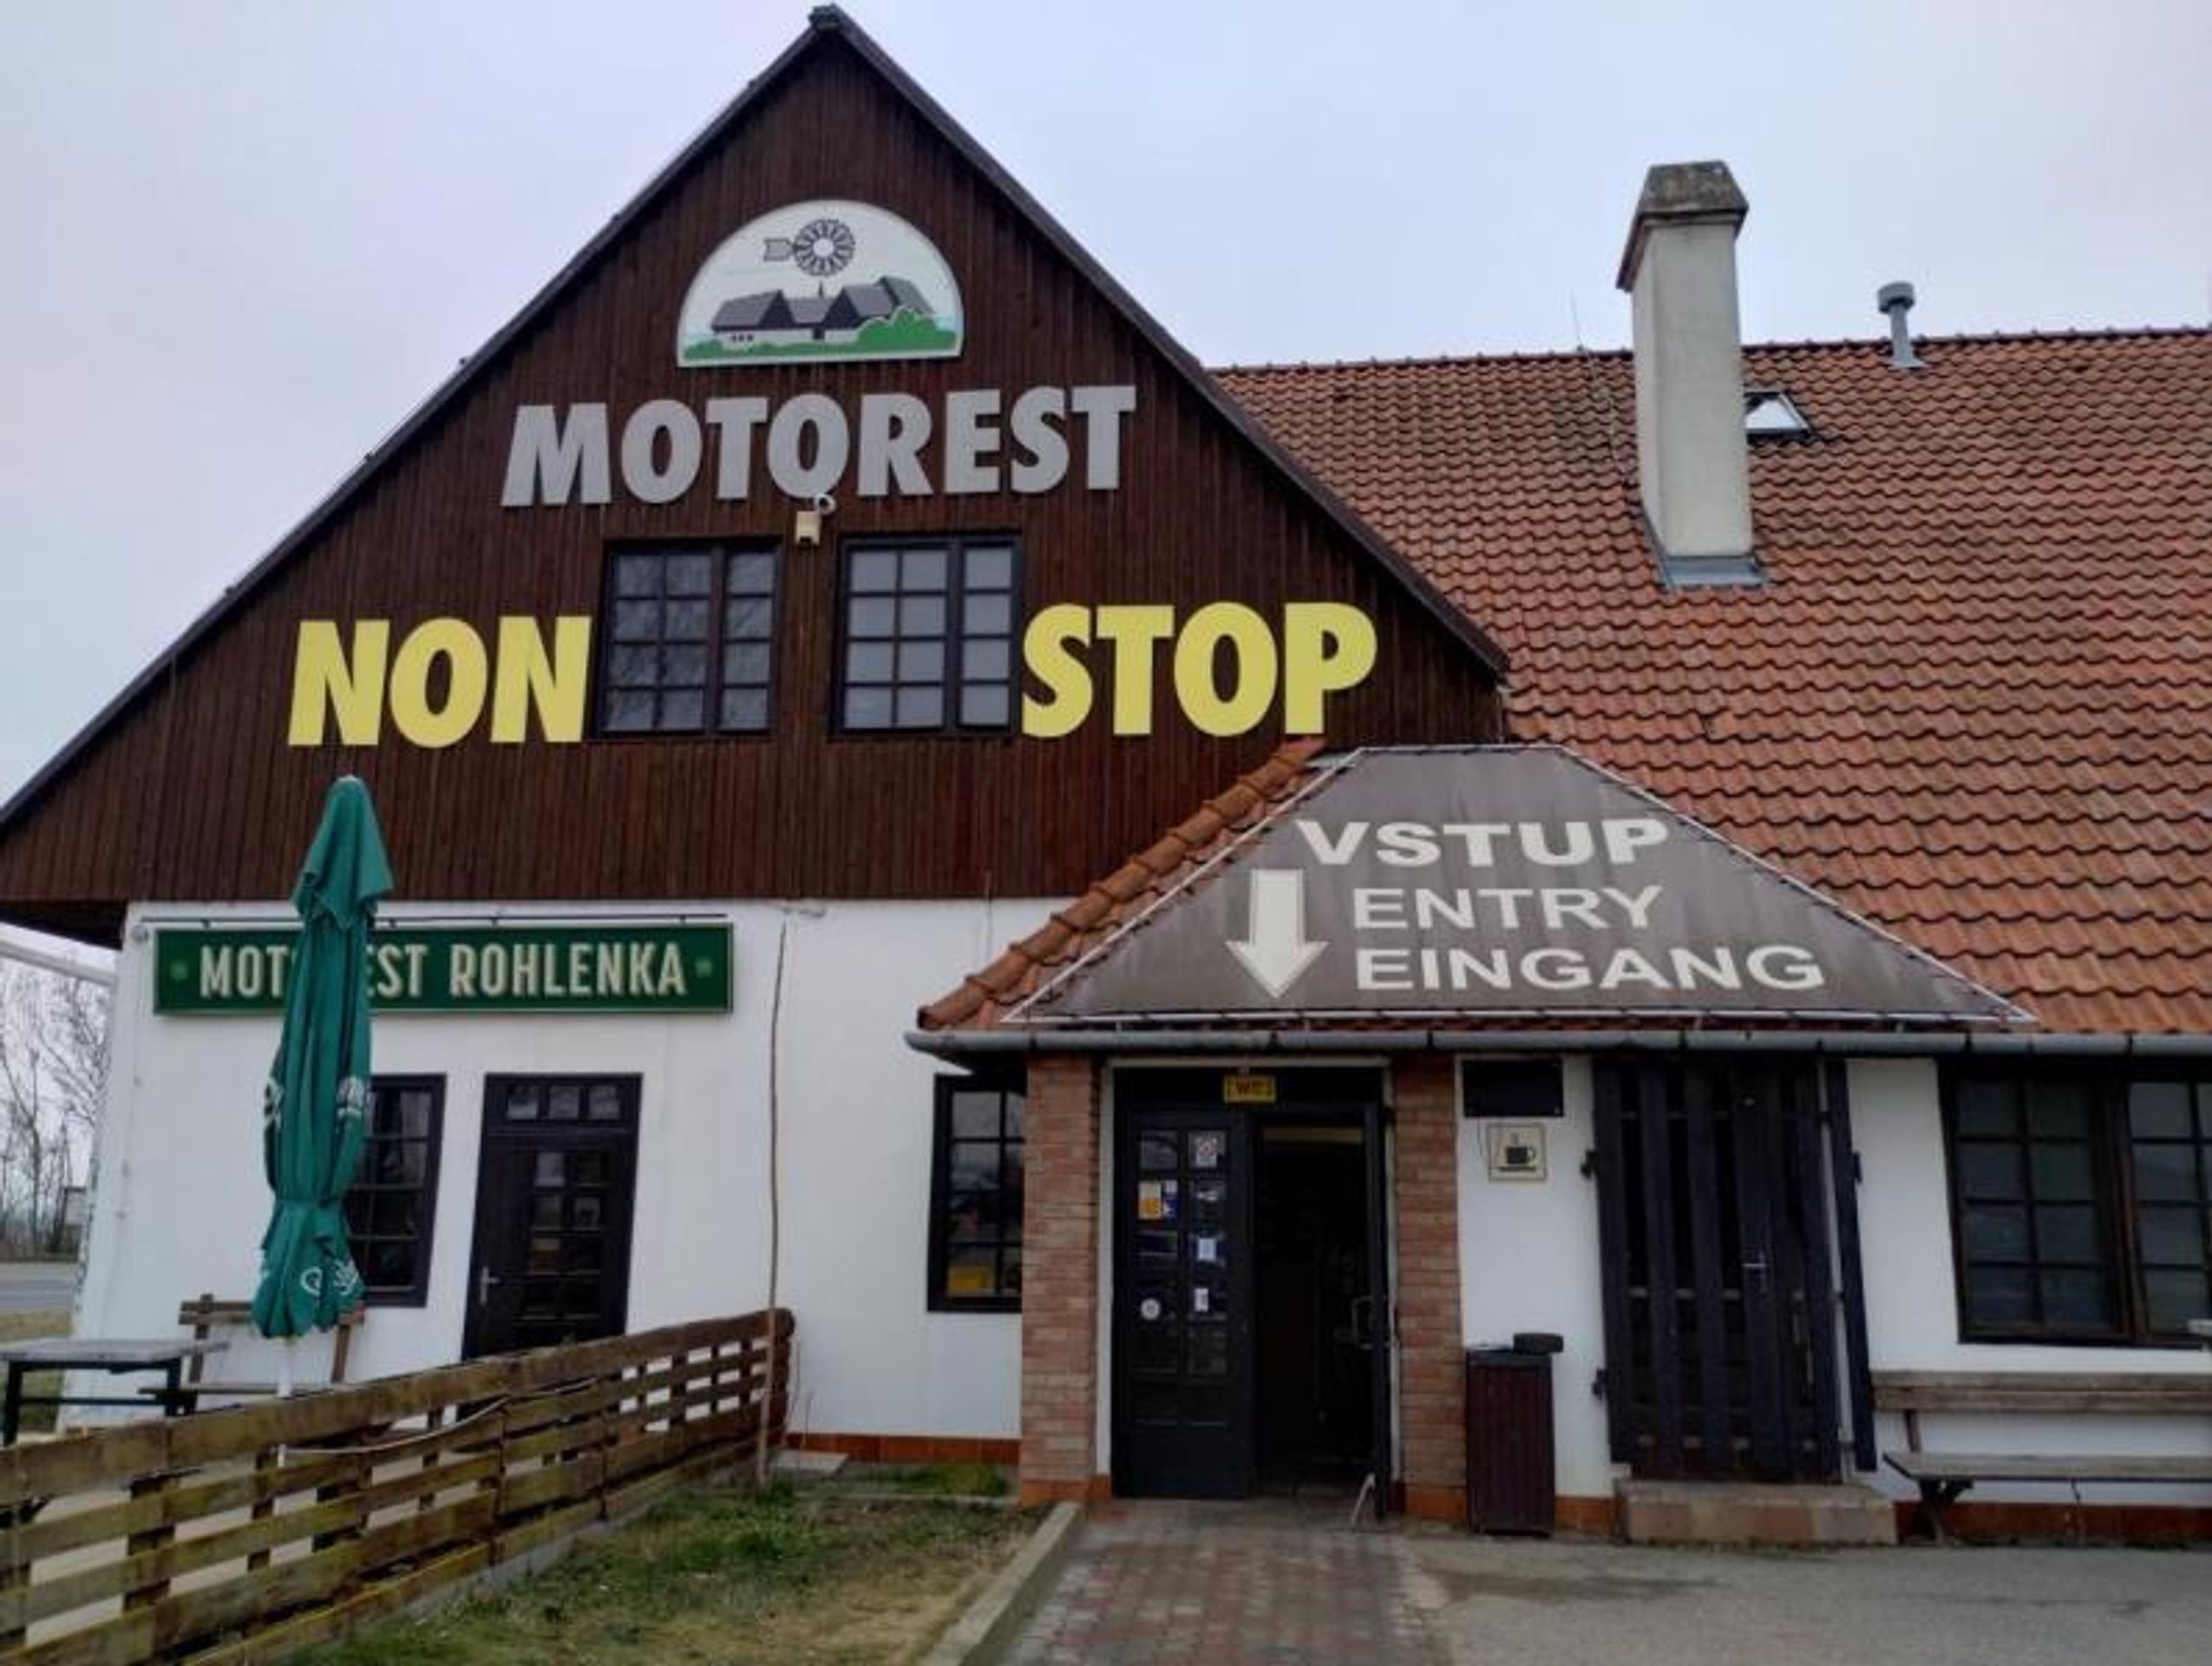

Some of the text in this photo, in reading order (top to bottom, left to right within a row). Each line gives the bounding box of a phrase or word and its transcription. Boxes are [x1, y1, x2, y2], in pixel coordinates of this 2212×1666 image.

[501, 385, 1136, 507] MOTOREST
[287, 602, 1378, 747] NON STOP
[1293, 818, 1670, 867] VSTUP
[1351, 884, 1664, 929] ENTRY
[200, 942, 687, 997] MOTST ROHLENKA
[1355, 945, 1825, 990] EINGANG
